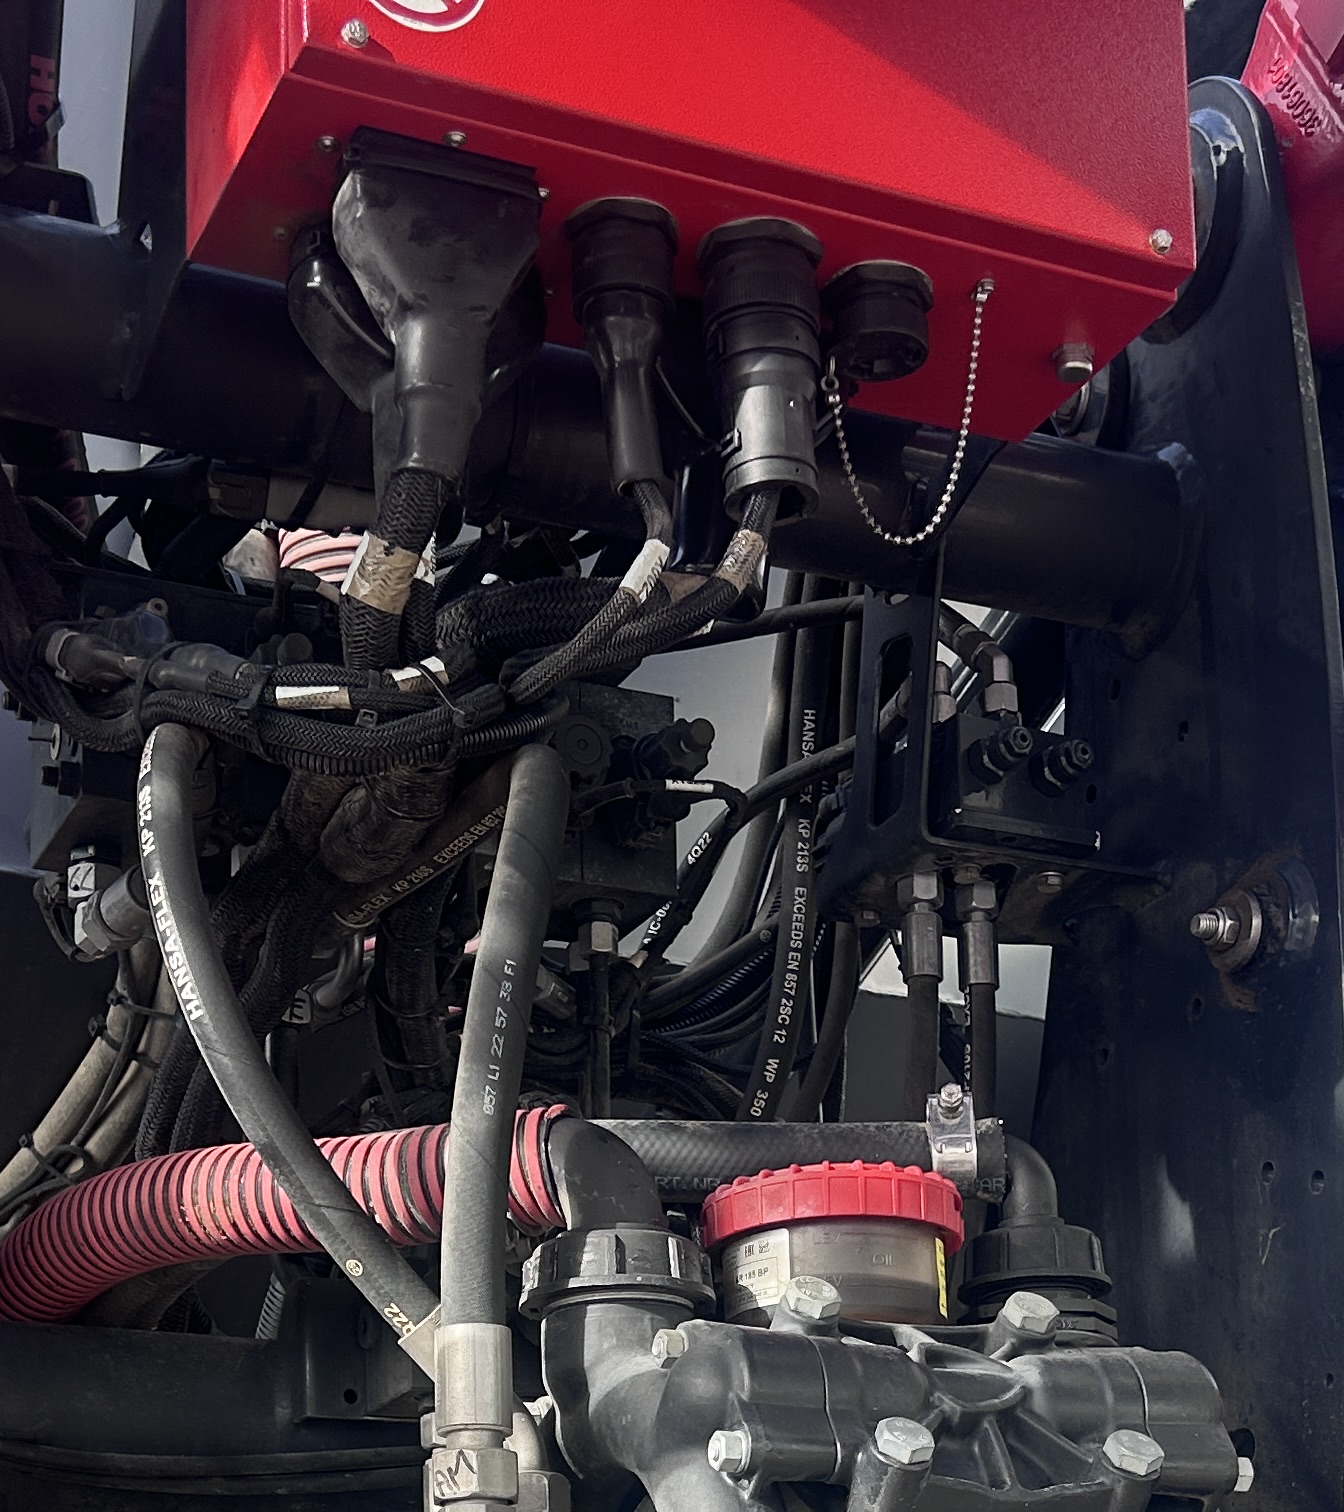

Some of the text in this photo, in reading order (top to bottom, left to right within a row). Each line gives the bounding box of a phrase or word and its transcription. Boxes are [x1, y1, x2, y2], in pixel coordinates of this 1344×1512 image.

[141, 827, 156, 858] KP
[798, 818, 811, 839] KP
[686, 831, 713, 866] 4Q22
[789, 886, 808, 949] EXCEEDS
[147, 872, 204, 1021] HANSA-FLEX
[788, 952, 802, 971] EN
[783, 973, 798, 997] 857
[494, 1006, 509, 1029] 57
[777, 997, 794, 1026] 2SC
[772, 1028, 788, 1045] 12
[762, 1057, 781, 1084] WP
[749, 1088, 770, 1118] 350
